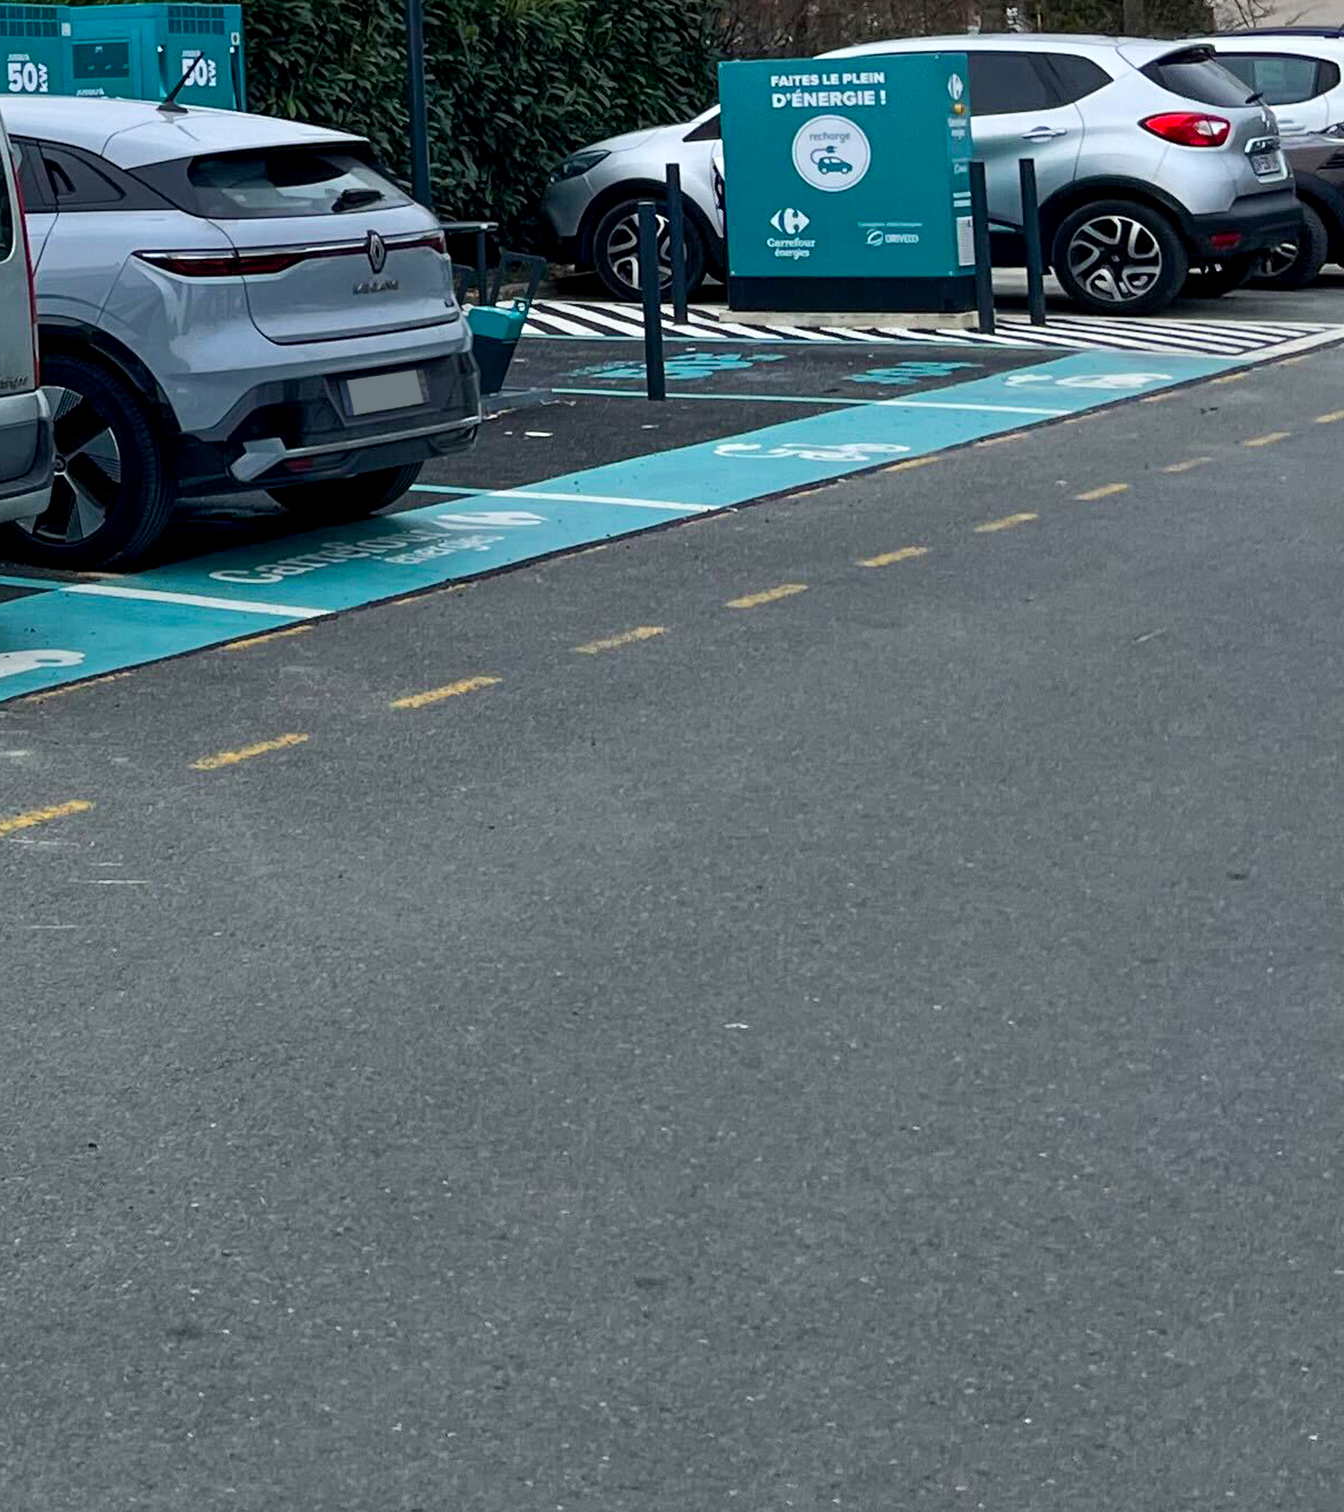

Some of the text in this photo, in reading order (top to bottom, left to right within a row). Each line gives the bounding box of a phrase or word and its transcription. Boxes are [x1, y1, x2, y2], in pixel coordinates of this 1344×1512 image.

[7, 62, 38, 92] 50
[182, 58, 208, 87] 50
[771, 72, 885, 87] FAITES LE PLEIN
[772, 89, 875, 108] D'ÉNERGIE
[809, 131, 850, 144] recharge
[766, 237, 815, 248] Carrefour
